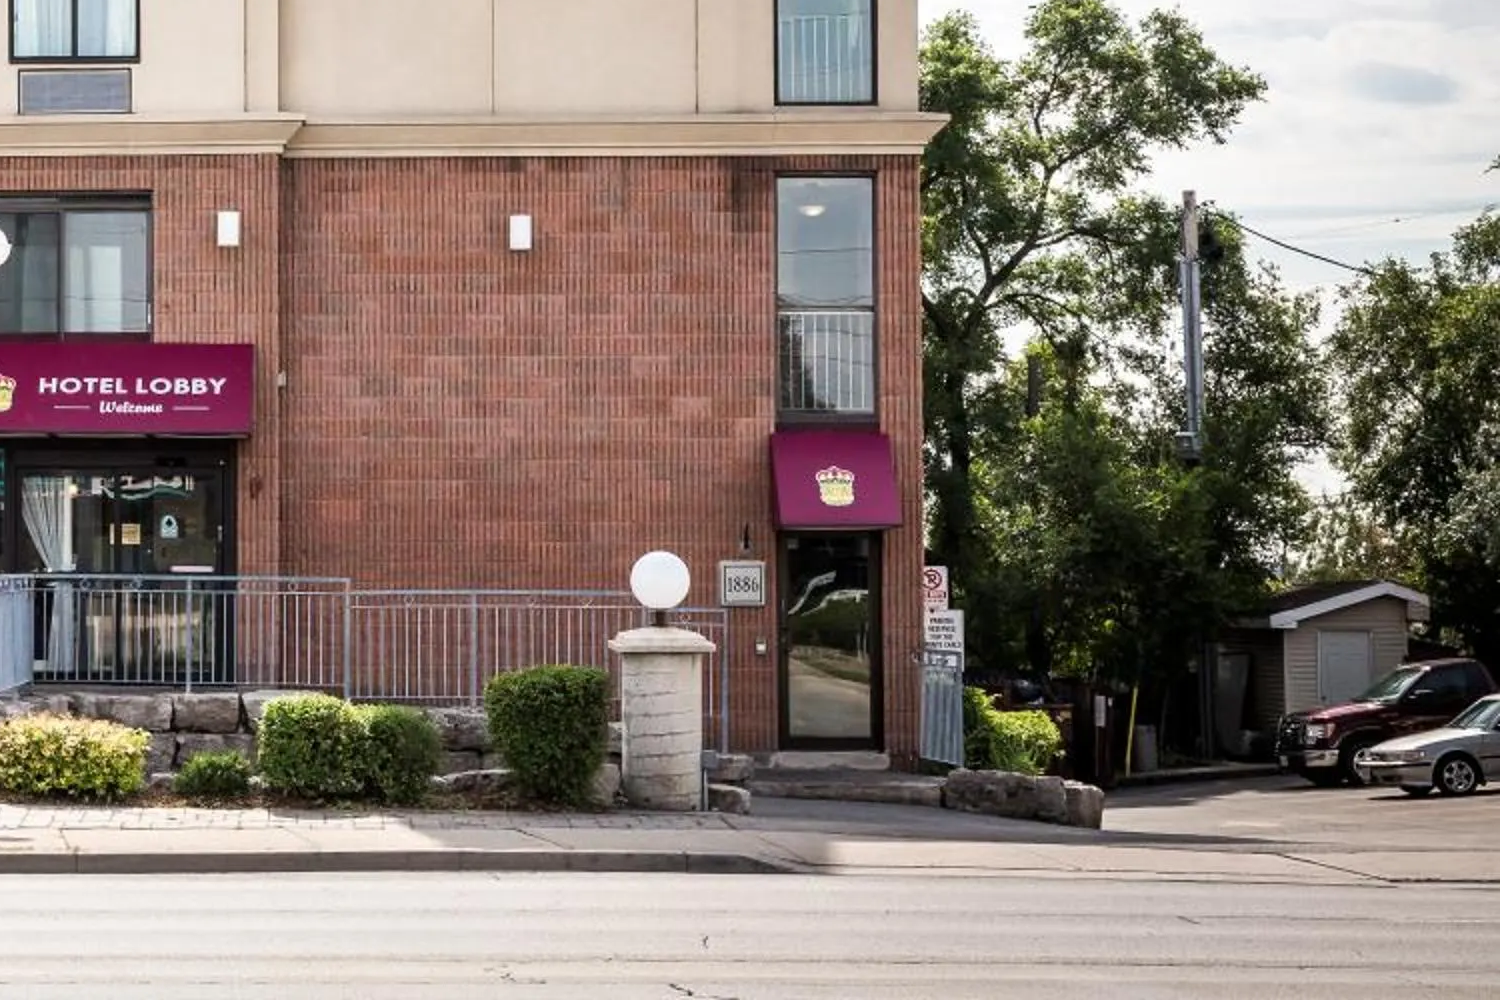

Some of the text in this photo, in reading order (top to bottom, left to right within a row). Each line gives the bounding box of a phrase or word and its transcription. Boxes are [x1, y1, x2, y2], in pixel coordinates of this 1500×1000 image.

[38, 377, 227, 396] HOTEL LOBBY
[99, 401, 164, 414] Welcome
[727, 575, 759, 593] 1886
